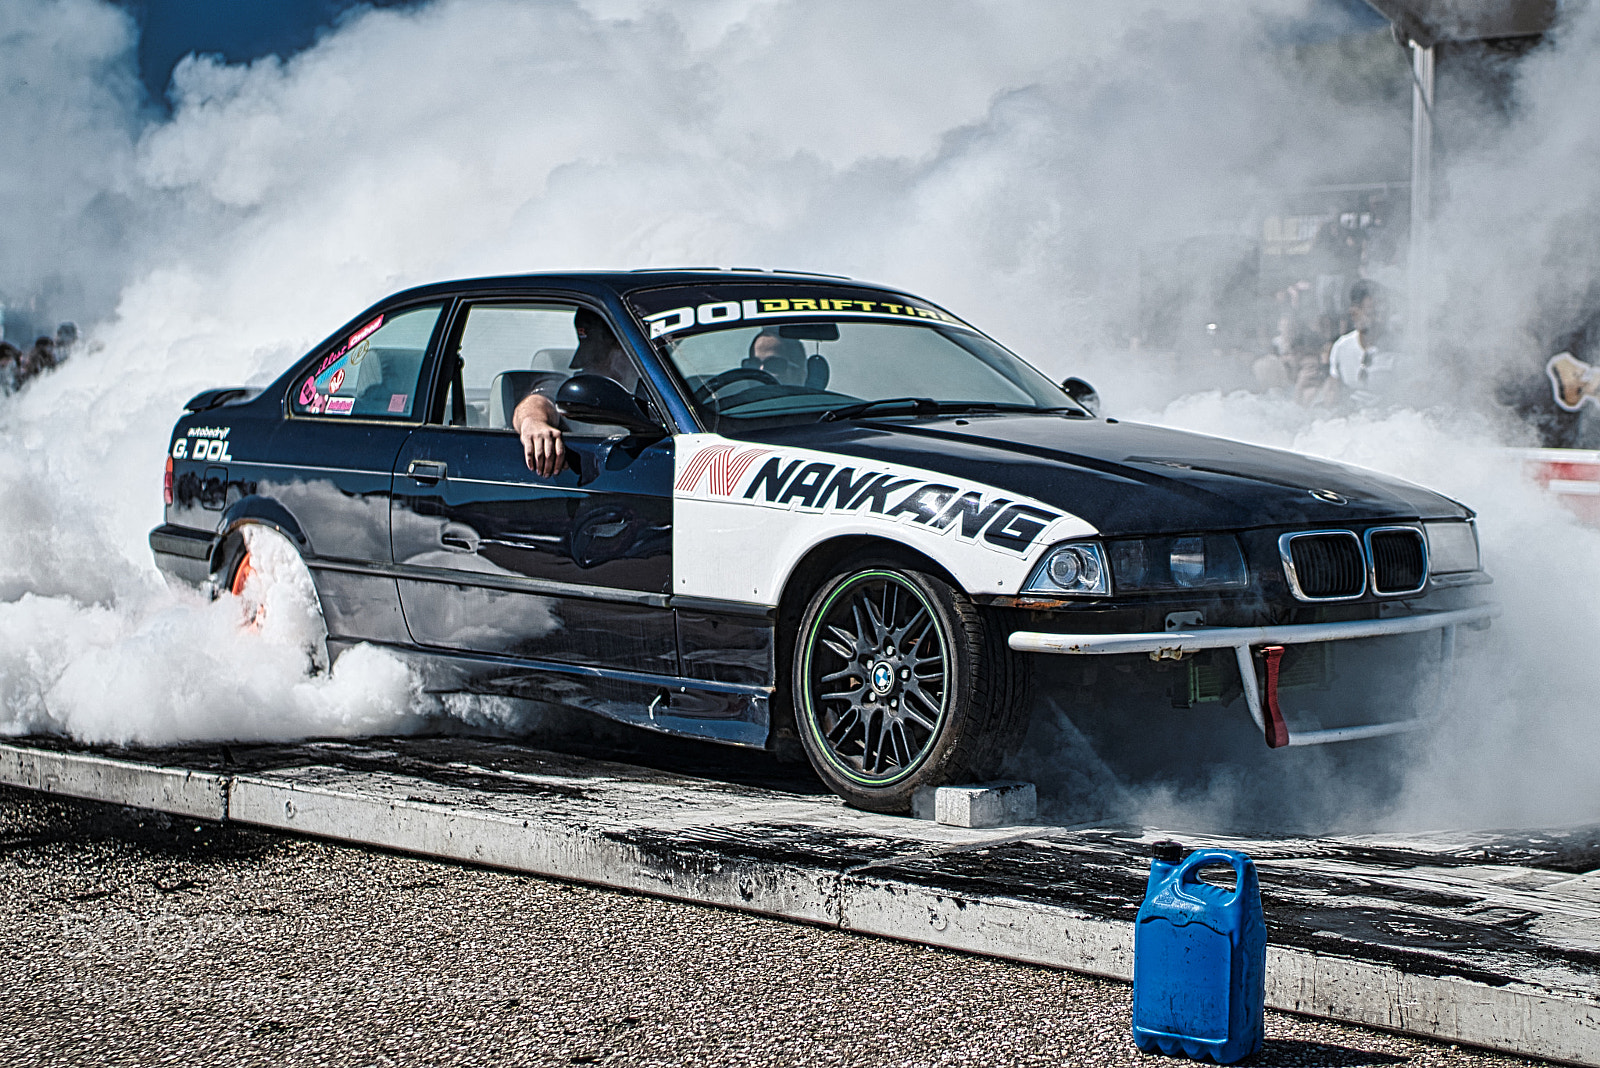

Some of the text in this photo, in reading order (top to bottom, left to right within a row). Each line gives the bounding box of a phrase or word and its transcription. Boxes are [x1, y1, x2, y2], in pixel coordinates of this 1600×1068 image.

[643, 300, 759, 339] DOL
[759, 298, 876, 313] DRIFT
[172, 437, 232, 463] G. DOL
[742, 456, 1063, 553] NANKANG
